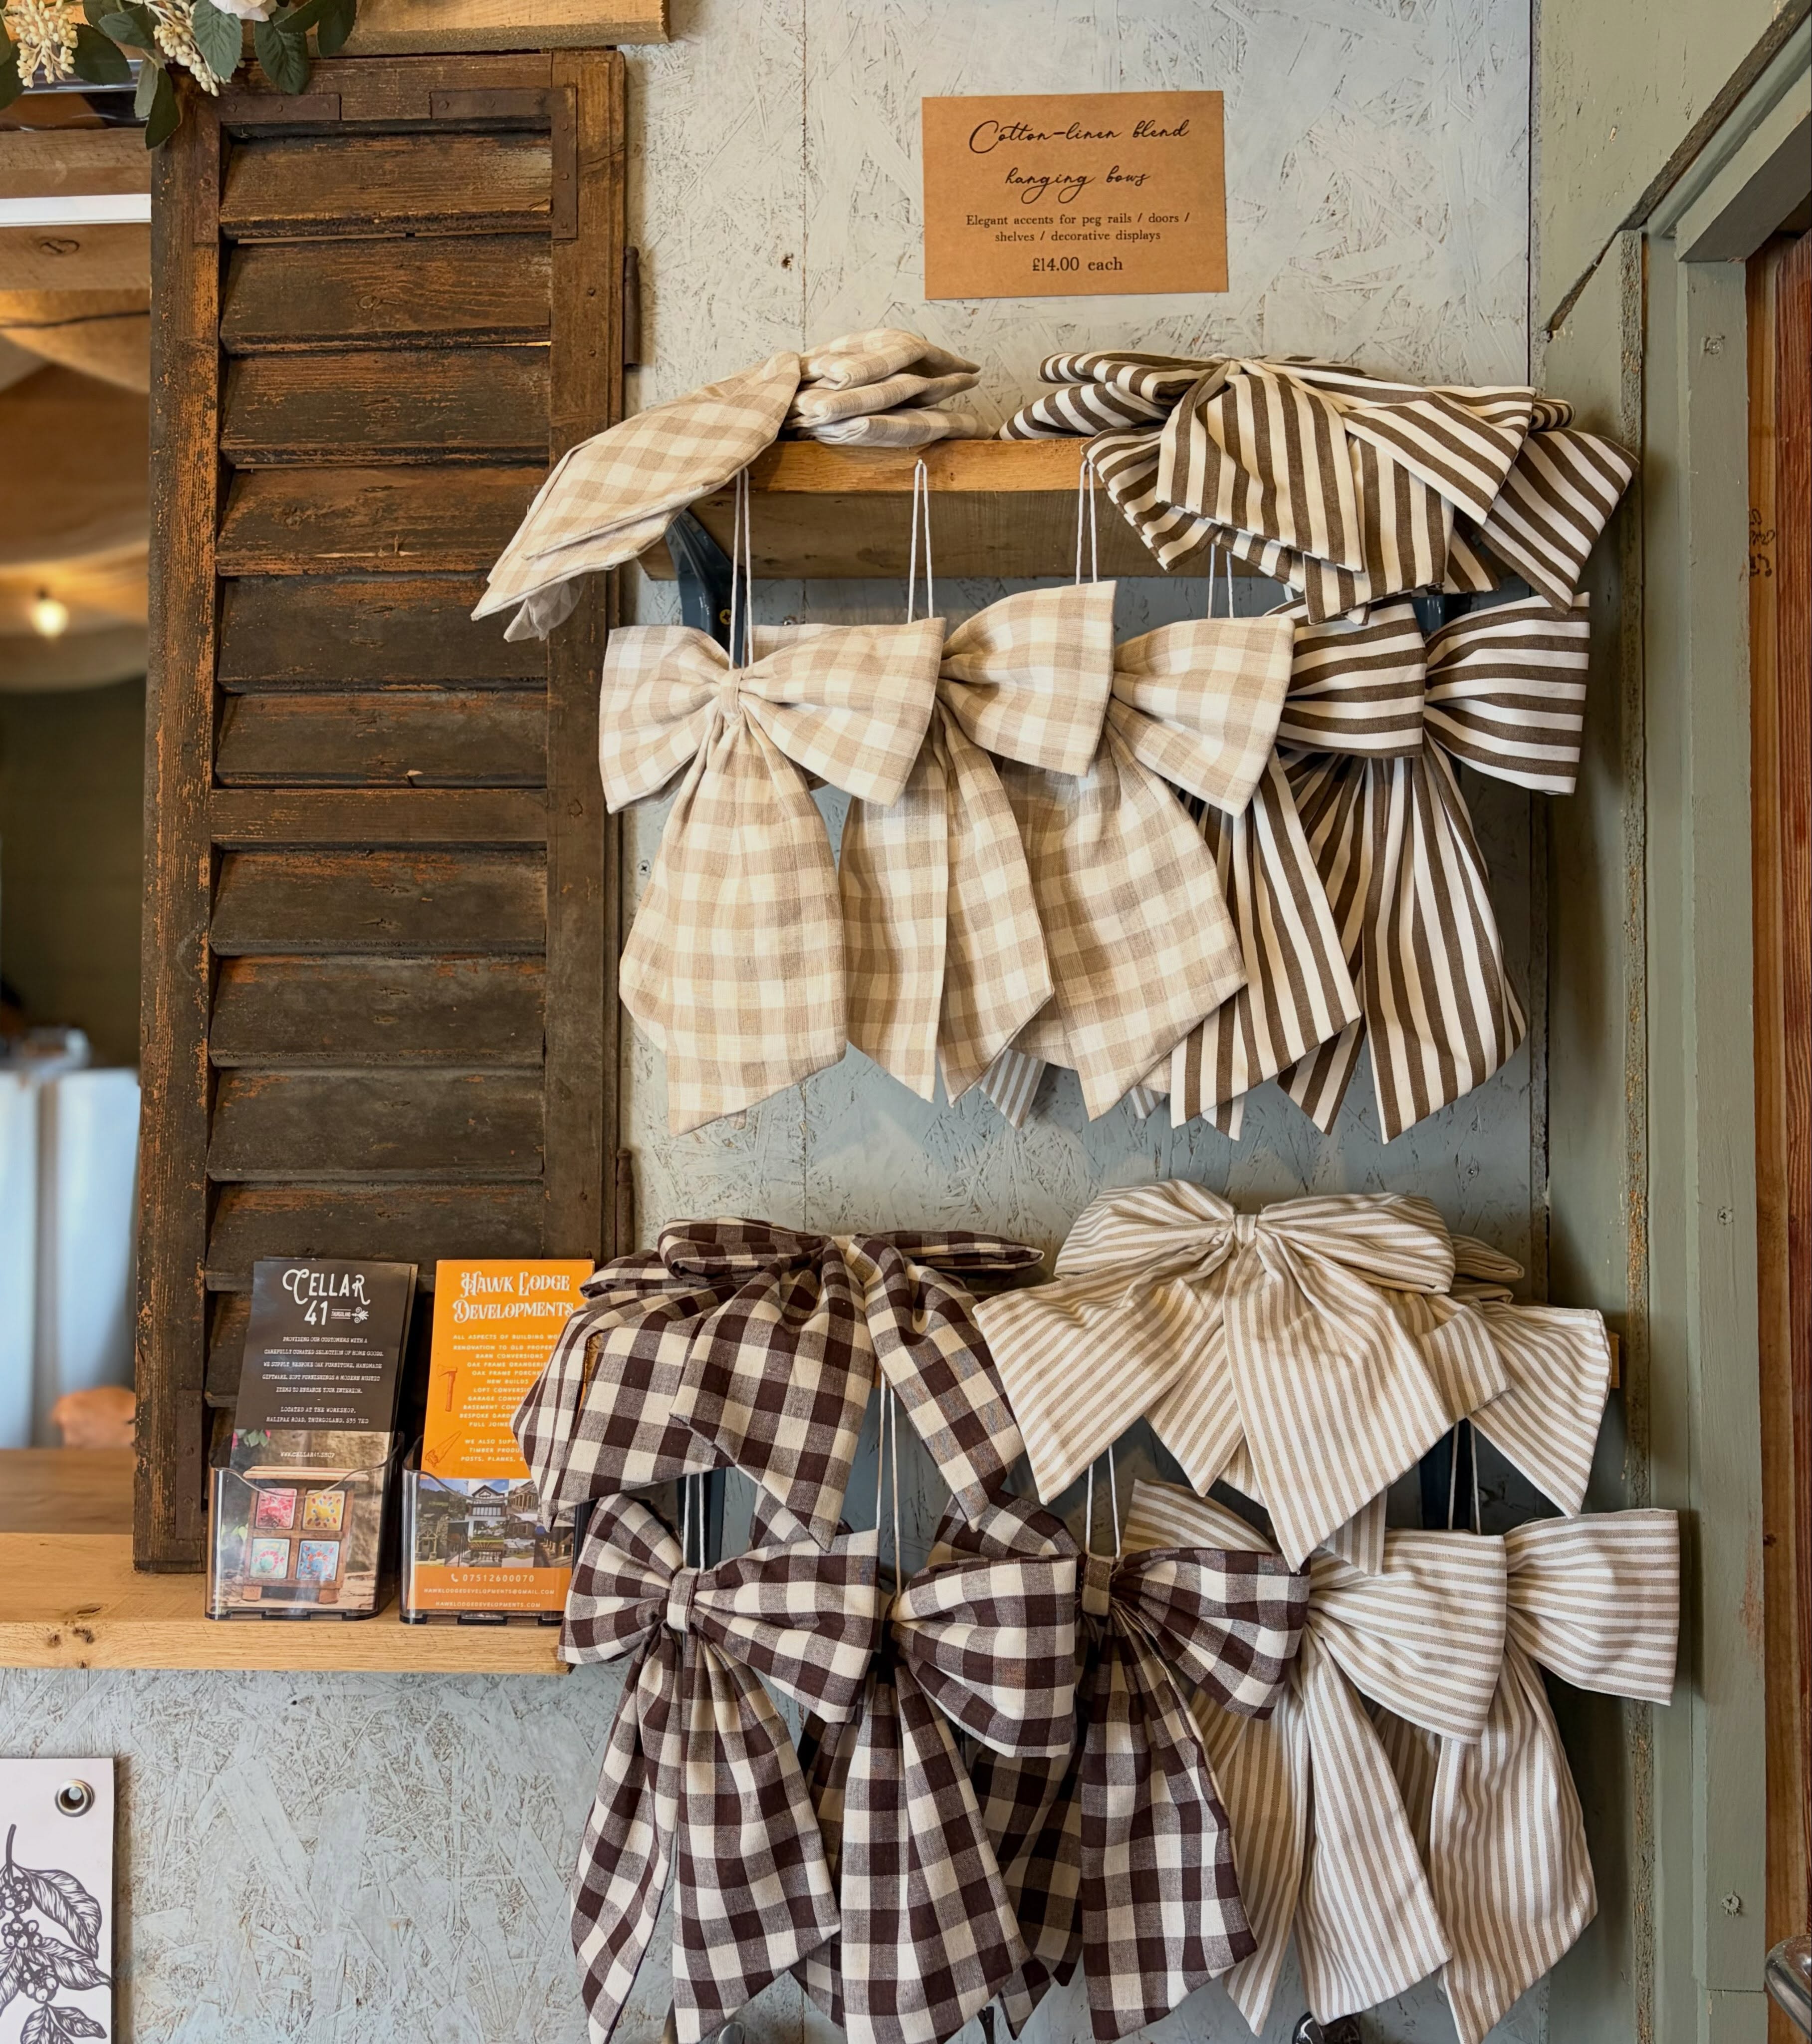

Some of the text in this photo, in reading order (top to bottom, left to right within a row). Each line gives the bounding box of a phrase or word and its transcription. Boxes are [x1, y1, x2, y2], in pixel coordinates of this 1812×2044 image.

[969, 119, 1190, 153] Cotton-linen blend
[1005, 165, 1151, 204] hanging bows
[966, 212, 1190, 228] Elegant accents for peg rails / doors /
[995, 230, 1161, 243] shelves / decorative displays
[1032, 256, 1123, 271] £14.00 each
[282, 1269, 371, 1305] CELLAR
[460, 1271, 570, 1297] HAWK LODGE
[304, 1300, 328, 1325] 41
[452, 1299, 574, 1323] DEVELOPMENTS
[462, 1574, 535, 1582] 07512600070
